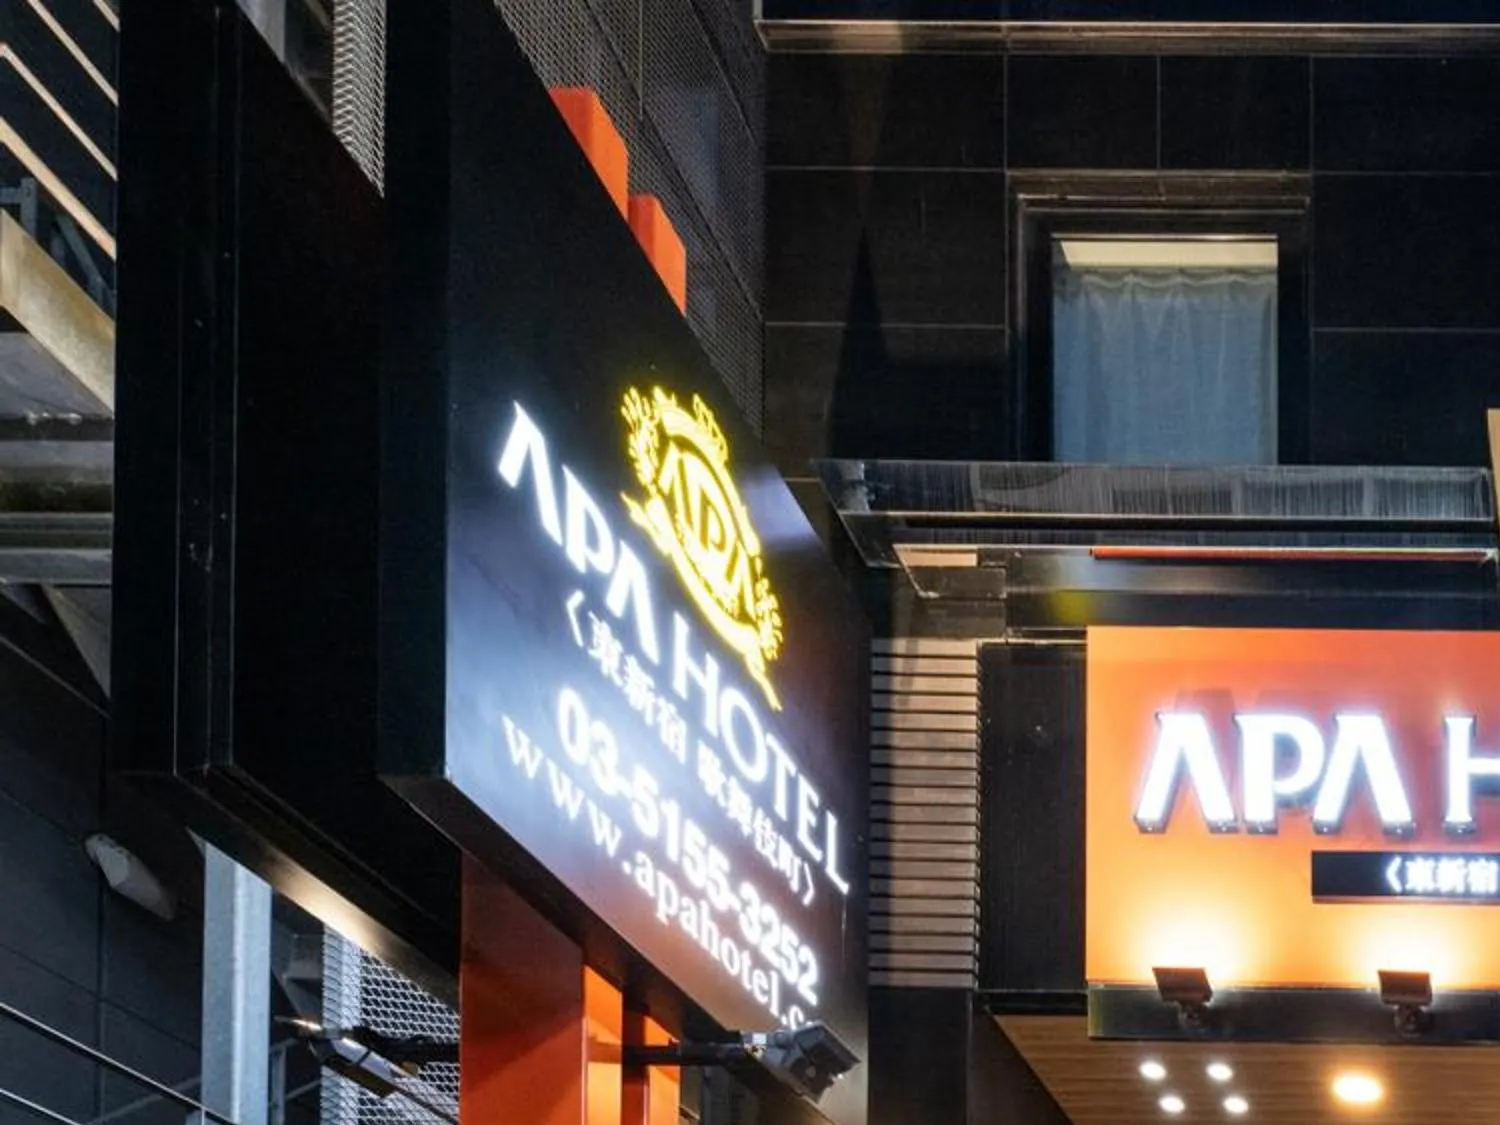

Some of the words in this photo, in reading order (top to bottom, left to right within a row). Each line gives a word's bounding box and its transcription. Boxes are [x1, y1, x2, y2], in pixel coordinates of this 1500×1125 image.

[498, 400, 660, 666] APA
[672, 610, 850, 894] HOTEL
[1133, 711, 1416, 833] APA
[501, 714, 806, 1029] www.apahotel.c
[557, 686, 818, 1006] 03-5155-3252
